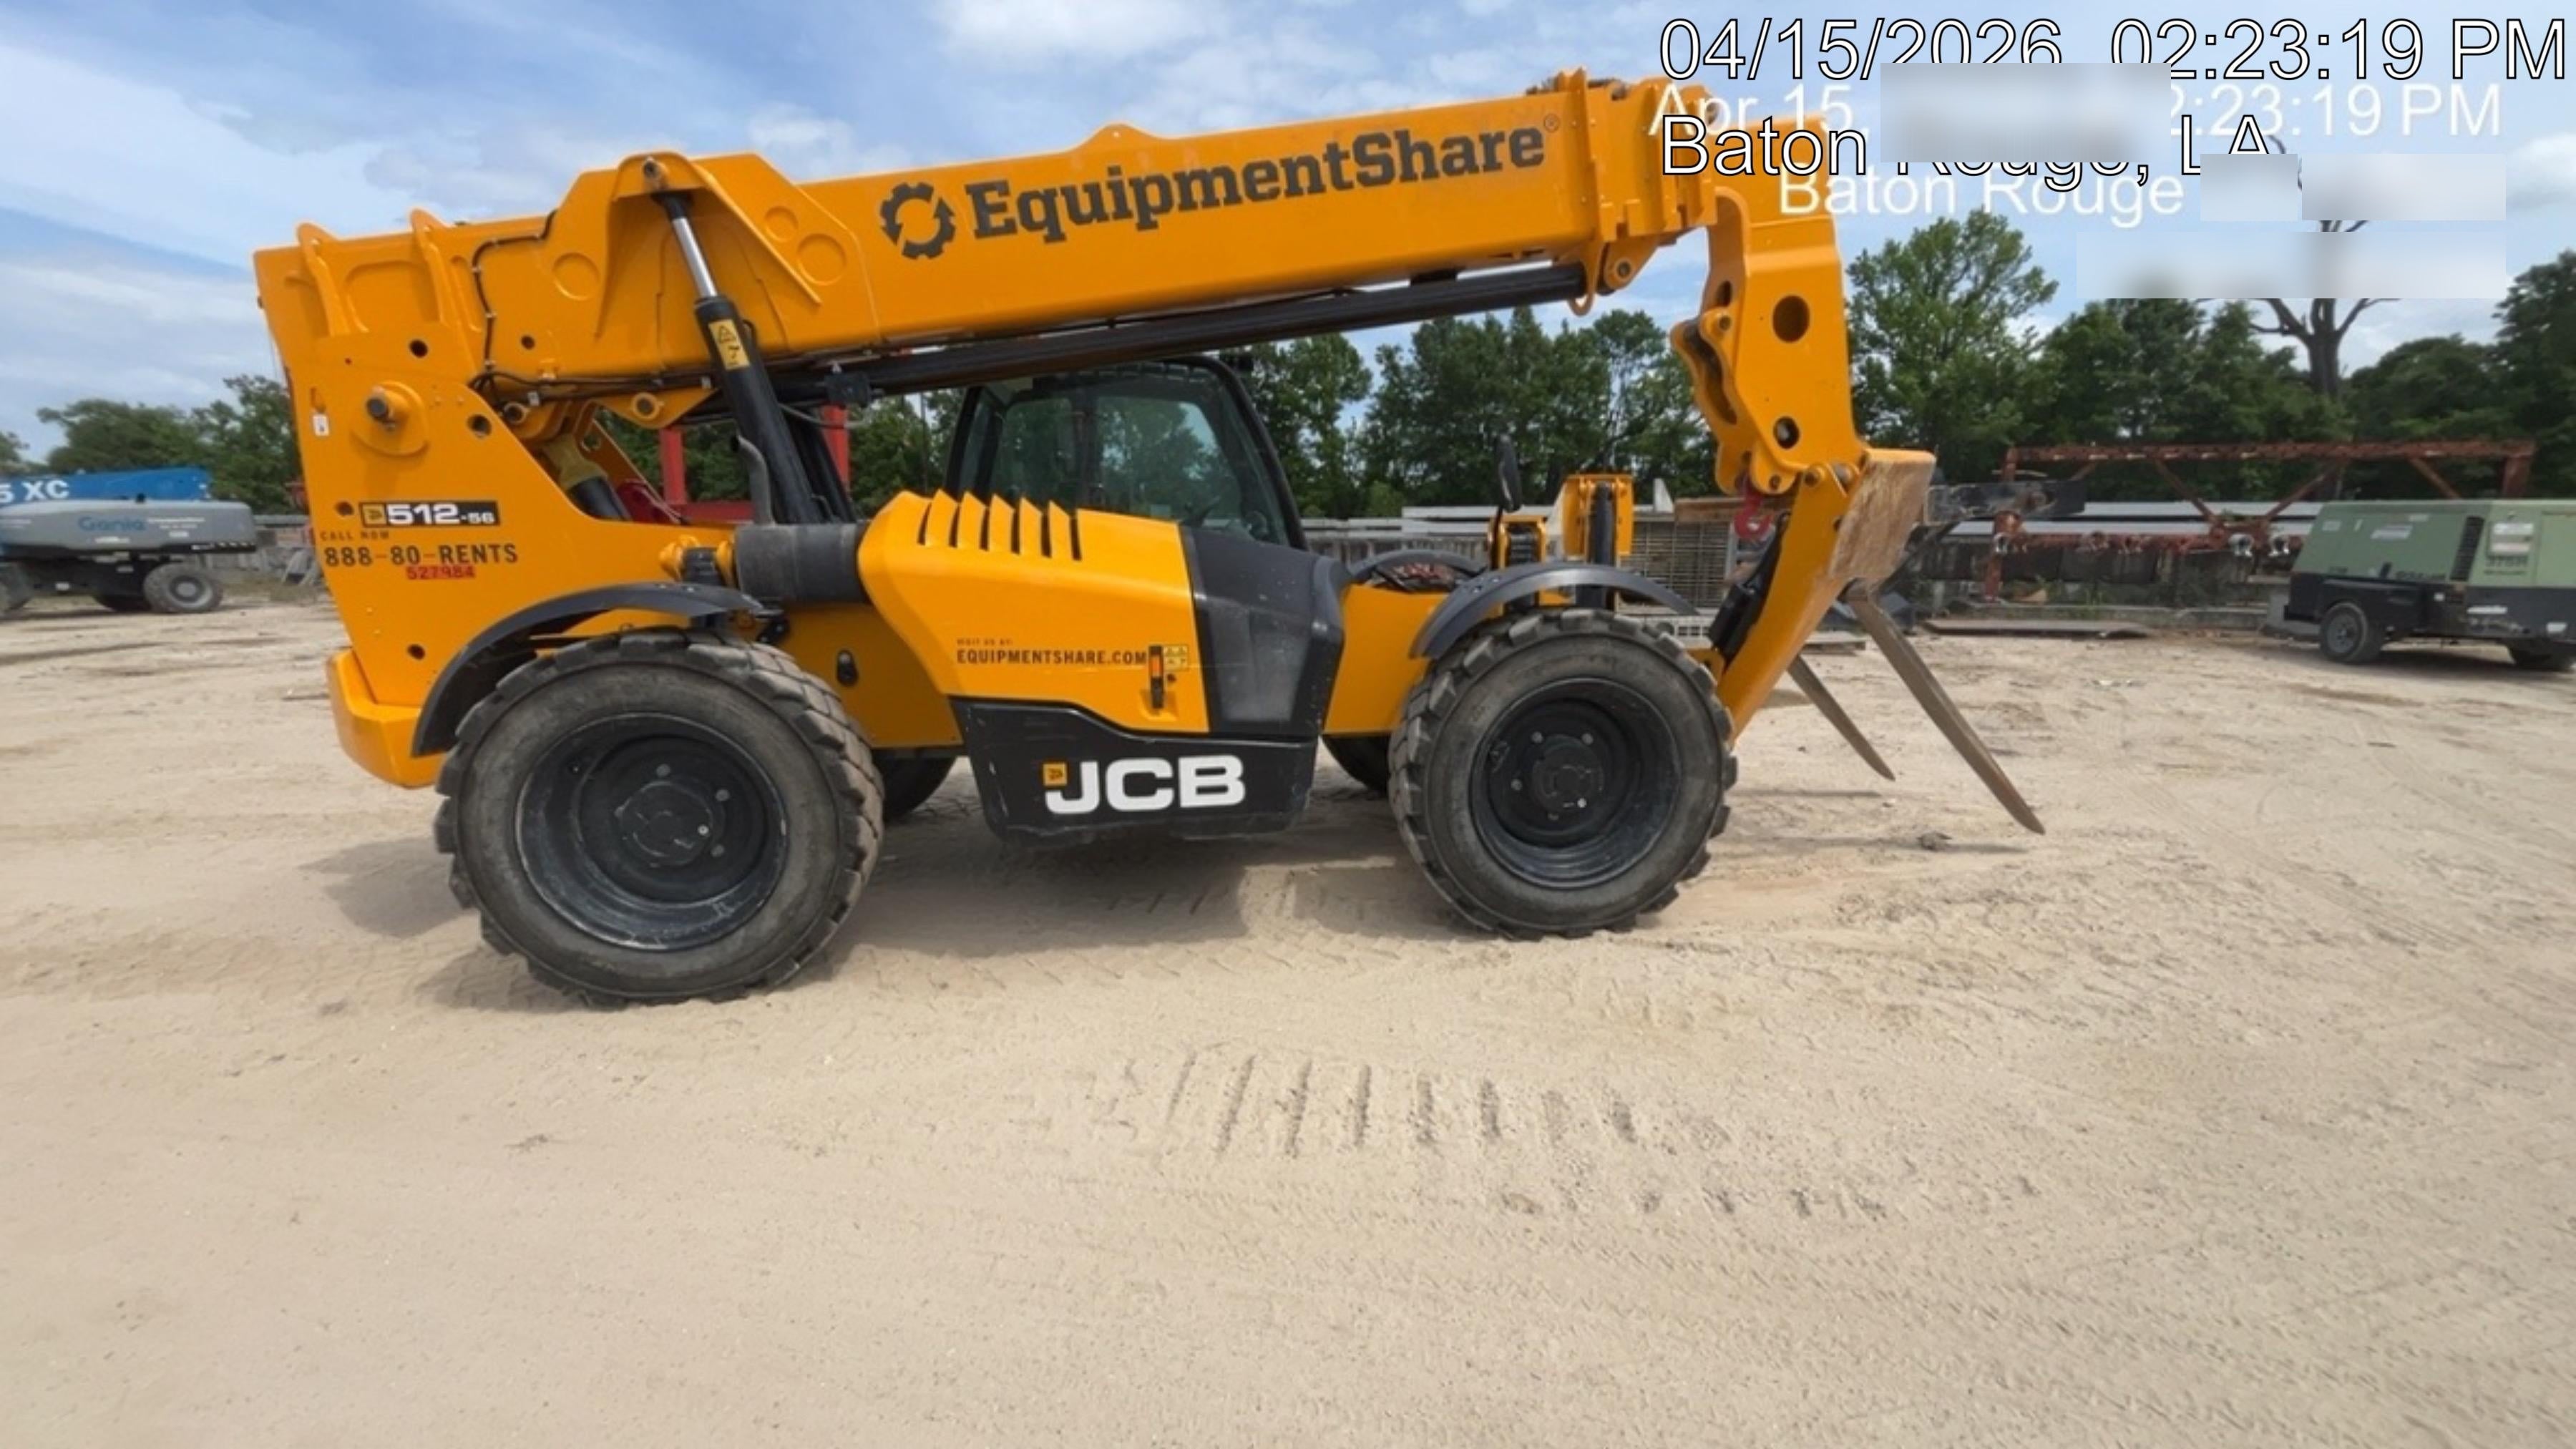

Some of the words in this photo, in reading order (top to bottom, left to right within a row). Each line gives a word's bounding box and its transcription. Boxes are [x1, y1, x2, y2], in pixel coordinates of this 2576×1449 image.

[965, 126, 1546, 244] EquipmentShare
[21, 479, 70, 502] XC
[386, 503, 495, 525] 512-56
[320, 530, 353, 541] CALL
[360, 530, 390, 540] NOW
[324, 542, 519, 567] 888-80-RENTS
[957, 649, 1146, 665] EQUIPMENTSHARE.COM
[1045, 755, 1246, 814] JCB
